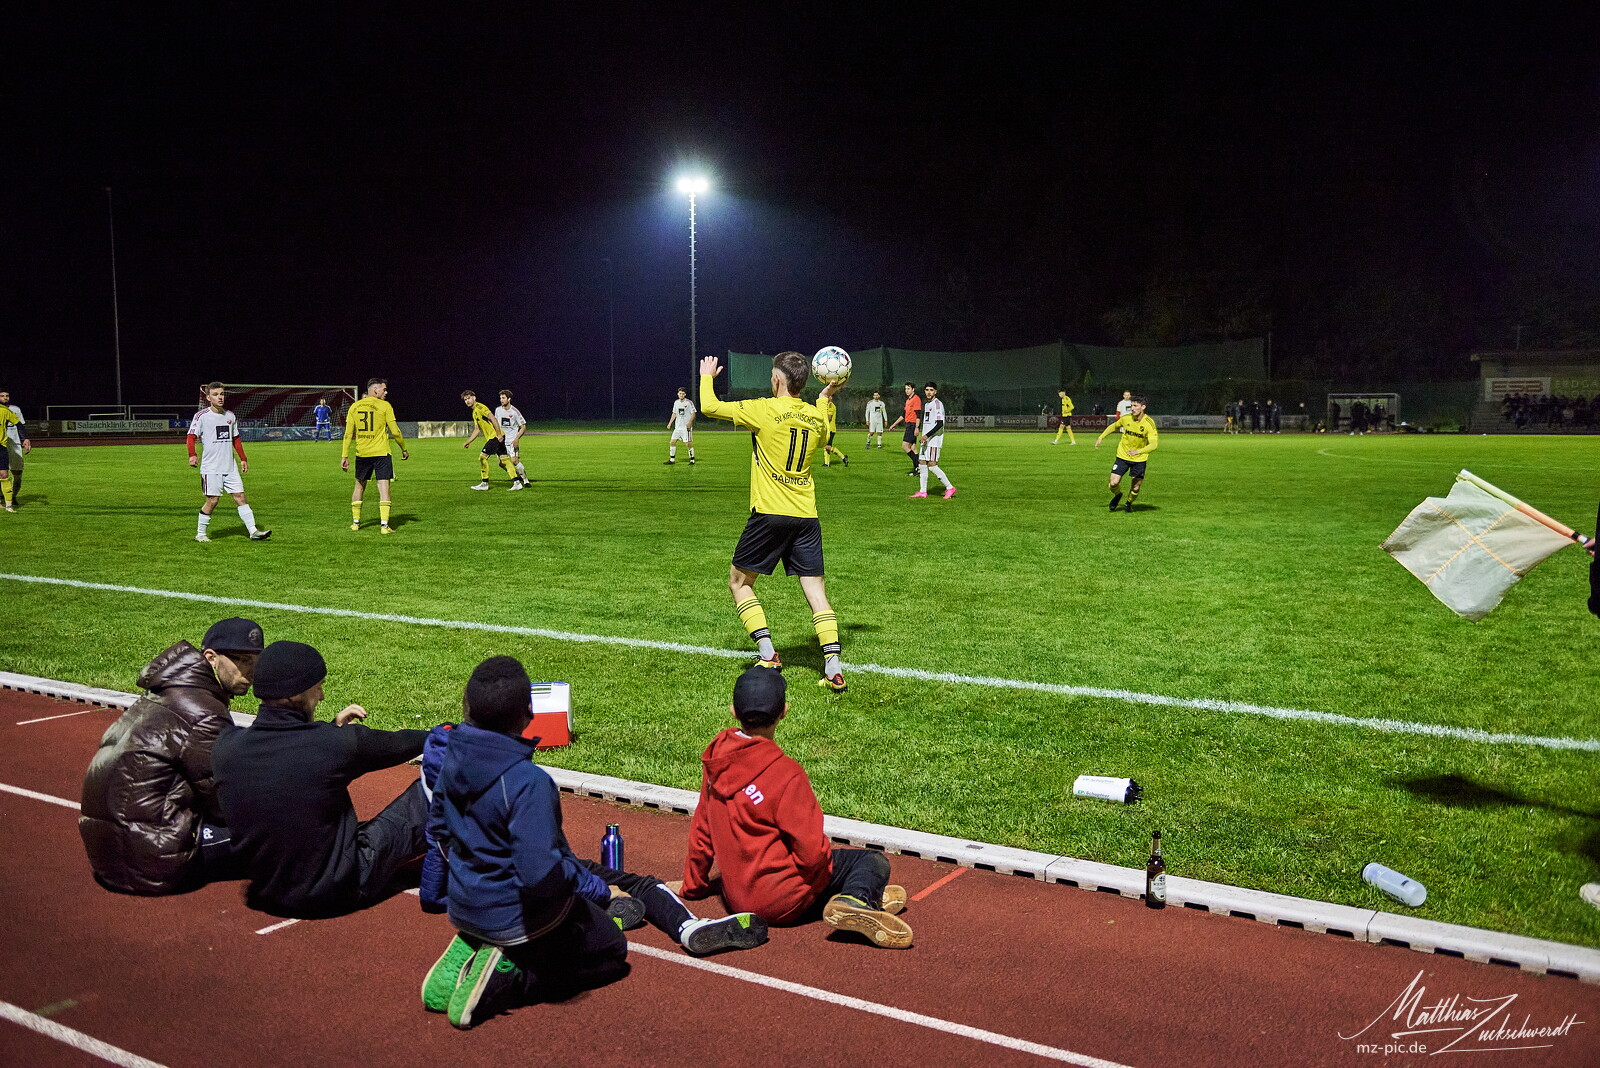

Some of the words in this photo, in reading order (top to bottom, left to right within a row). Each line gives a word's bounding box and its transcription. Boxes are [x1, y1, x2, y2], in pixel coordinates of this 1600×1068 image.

[1492, 380, 1543, 393] ESB
[77, 421, 126, 429] Salzachklinik
[128, 421, 163, 430] Fridolfing
[357, 411, 374, 432] 31
[785, 427, 809, 472] 11
[742, 784, 764, 805] en
